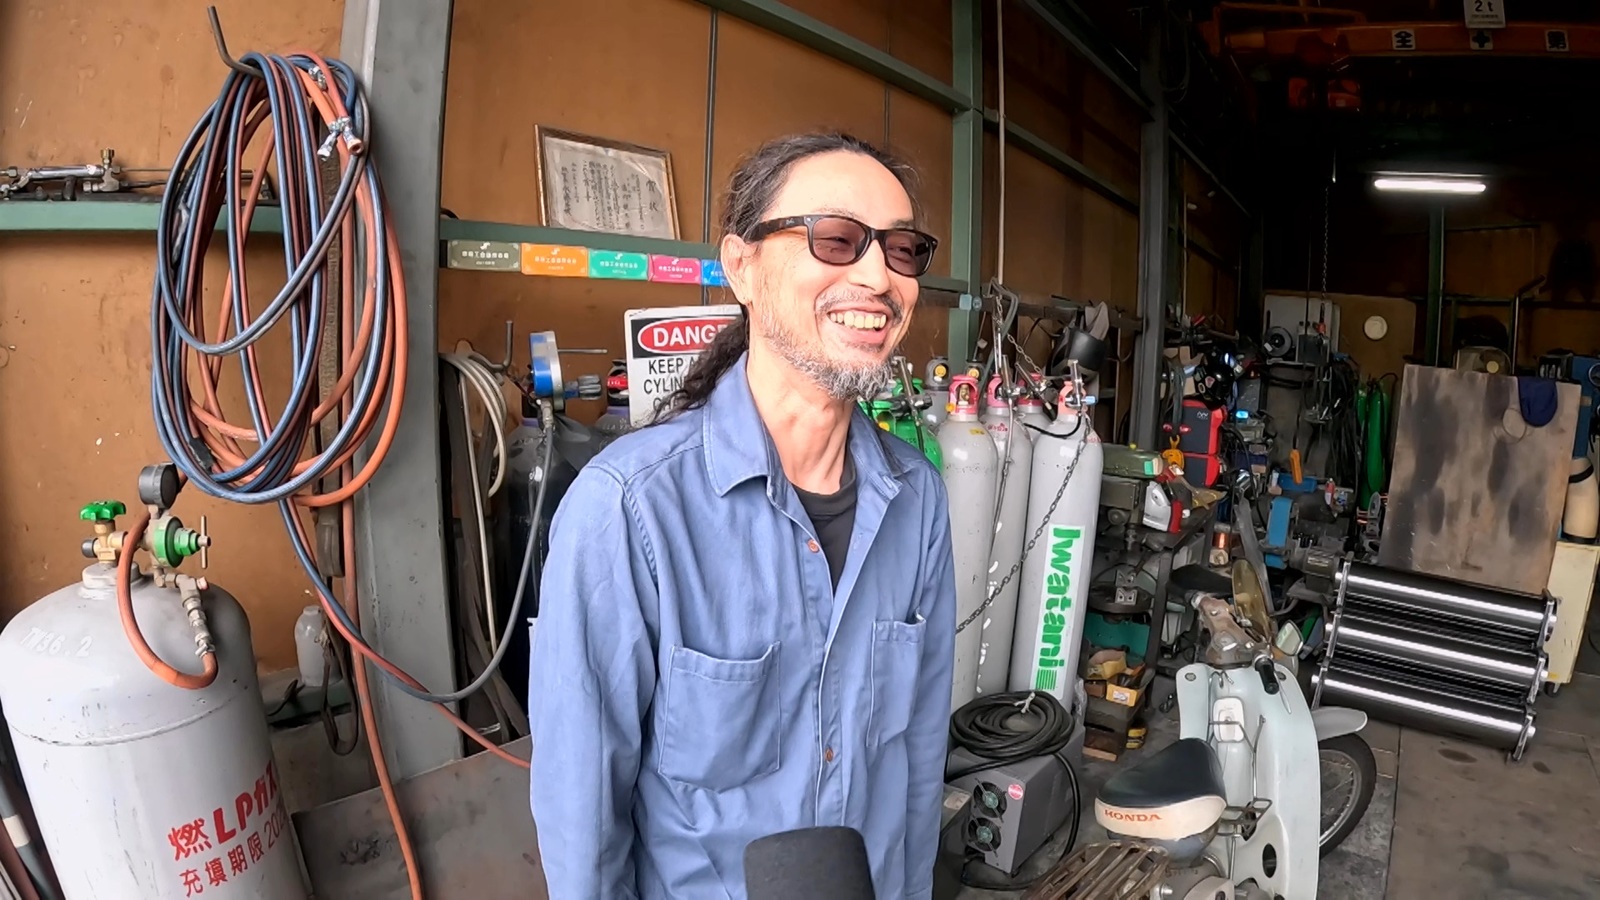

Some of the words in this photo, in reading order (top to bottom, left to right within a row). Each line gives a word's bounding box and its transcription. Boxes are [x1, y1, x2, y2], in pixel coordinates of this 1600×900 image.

[1394, 31, 1413, 49] 全
[653, 324, 728, 348] DANG
[648, 357, 684, 375] KEEP
[643, 376, 684, 395] CYLIN
[1038, 527, 1081, 668] Iwatani
[1104, 809, 1162, 822] HONDA
